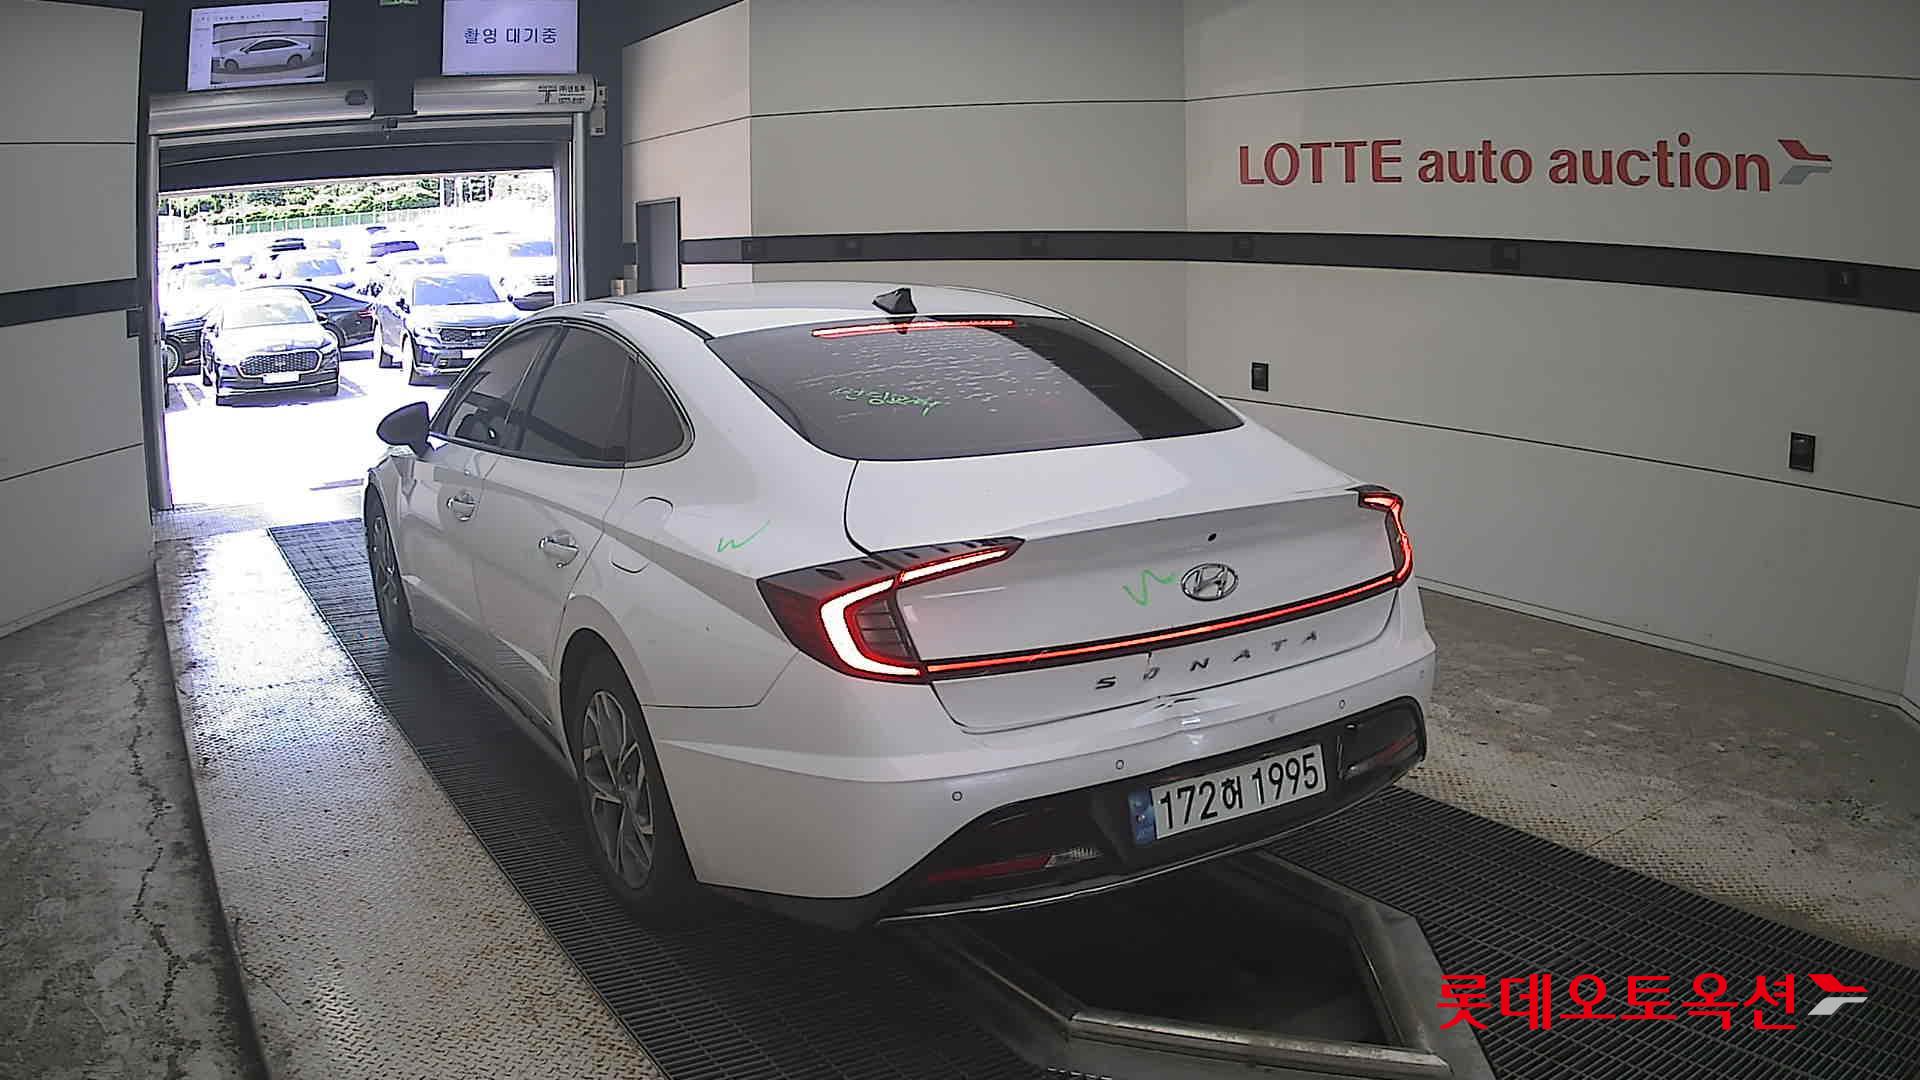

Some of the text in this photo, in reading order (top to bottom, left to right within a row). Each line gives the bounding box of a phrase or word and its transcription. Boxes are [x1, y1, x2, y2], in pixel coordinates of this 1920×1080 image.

[505, 27, 558, 44] 대기중
[1239, 132, 1771, 192] LOTTE auto auction
[1095, 630, 1318, 689] SONATA
[1251, 752, 1319, 806] 1995
